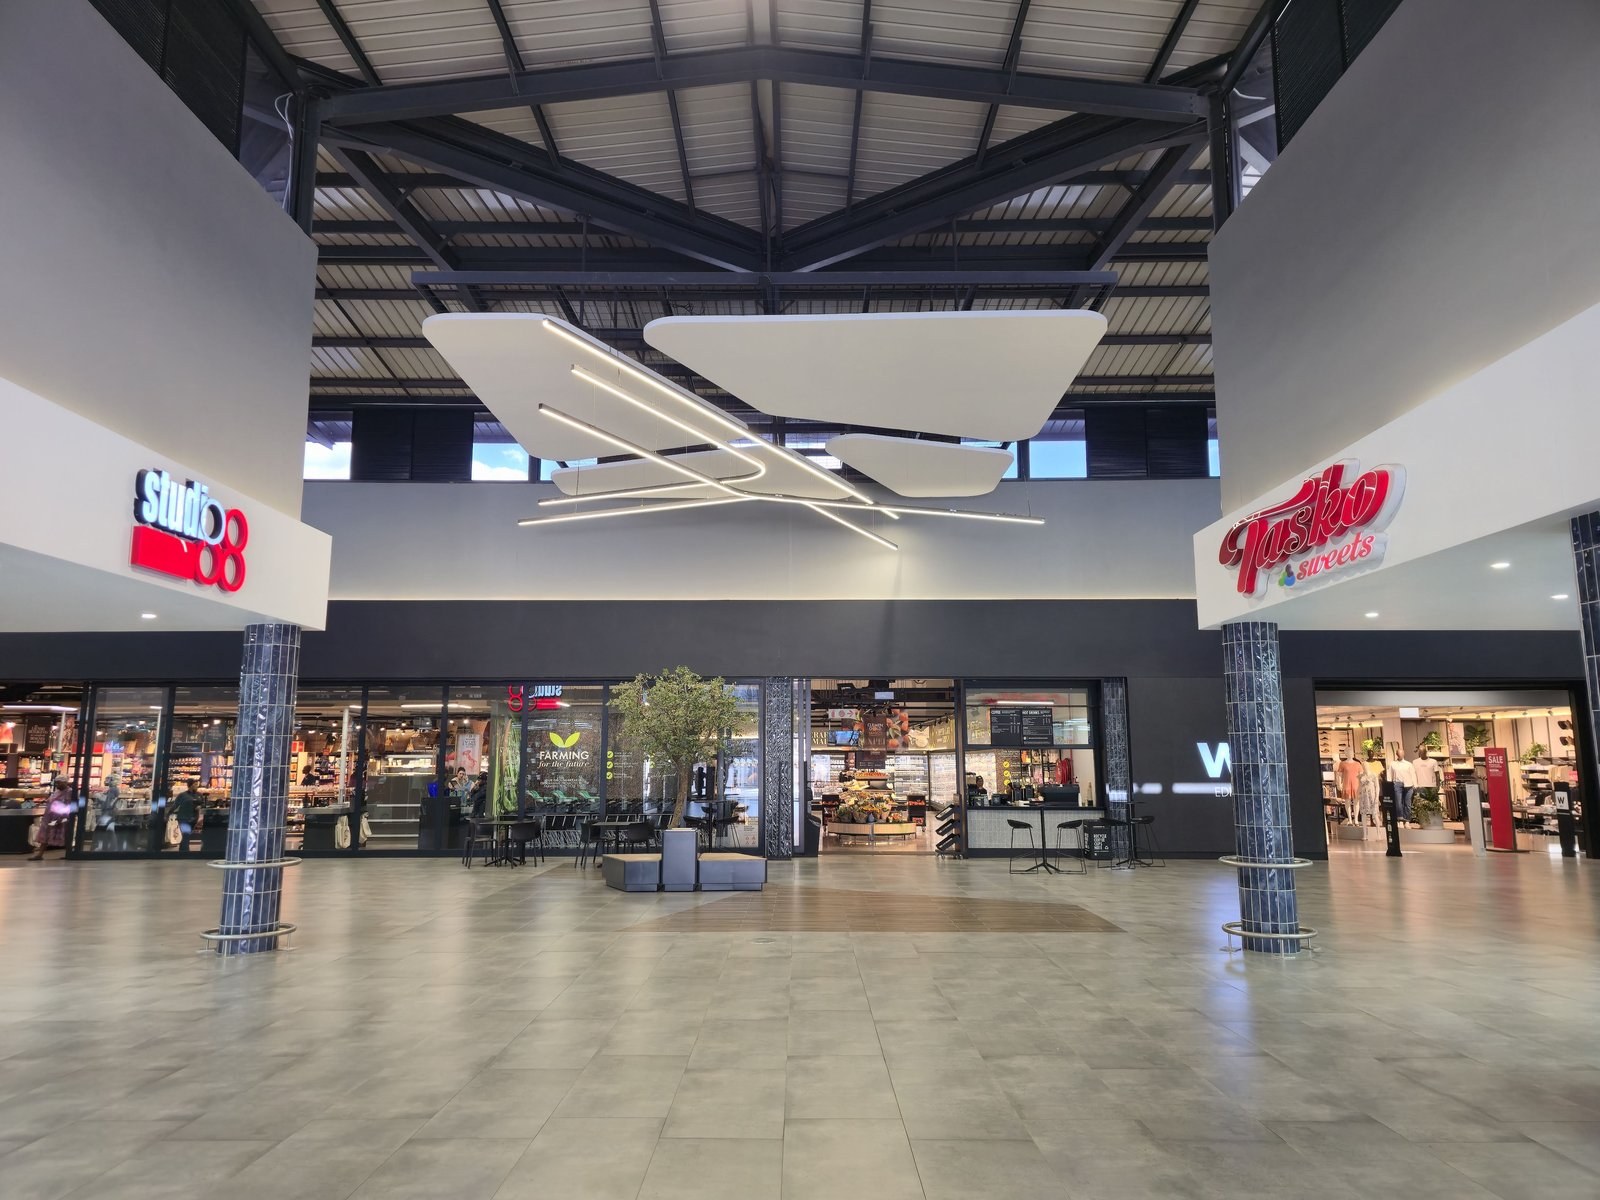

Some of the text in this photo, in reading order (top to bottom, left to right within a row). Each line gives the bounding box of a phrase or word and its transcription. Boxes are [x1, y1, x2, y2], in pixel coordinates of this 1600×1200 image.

[134, 467, 226, 546] studio
[1219, 464, 1390, 594] Tasko
[1296, 531, 1376, 581] sweets
[539, 751, 590, 760] FARMING
[1488, 755, 1504, 764] SALE
[537, 761, 549, 769] for
[564, 761, 590, 769] future
[1215, 787, 1232, 797] EDI
[1557, 795, 1565, 804] W
